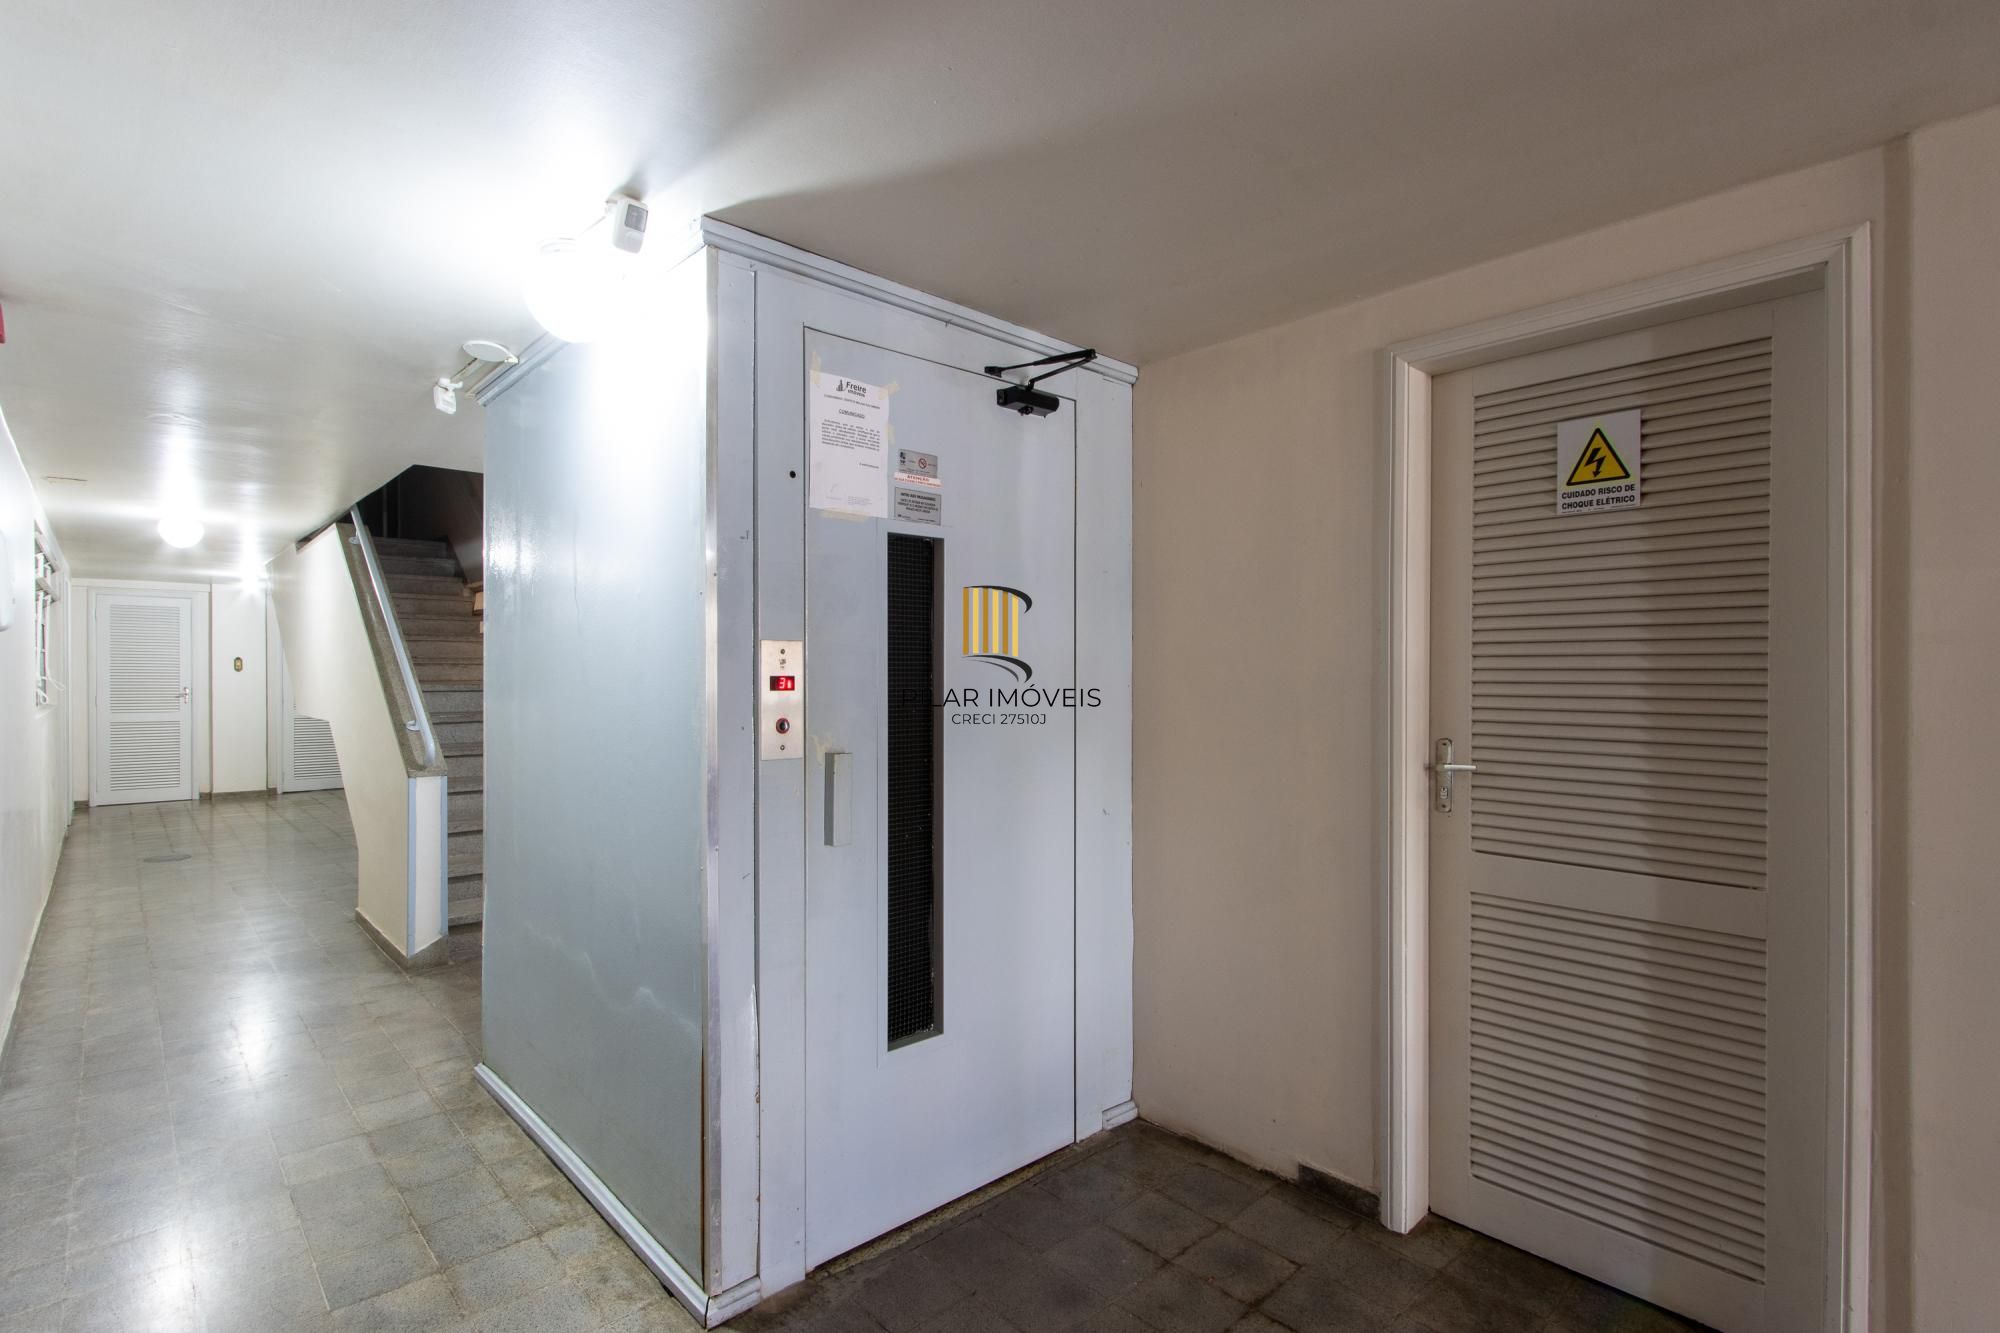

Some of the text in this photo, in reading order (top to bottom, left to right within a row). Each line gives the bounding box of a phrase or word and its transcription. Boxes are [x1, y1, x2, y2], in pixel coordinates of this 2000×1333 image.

[846, 381, 867, 394] Freire
[1561, 484, 1635, 499] CUIDADO RISCO DE
[1561, 499, 1594, 509] CHOQUE
[1596, 495, 1635, 505] ELÉTRICO
